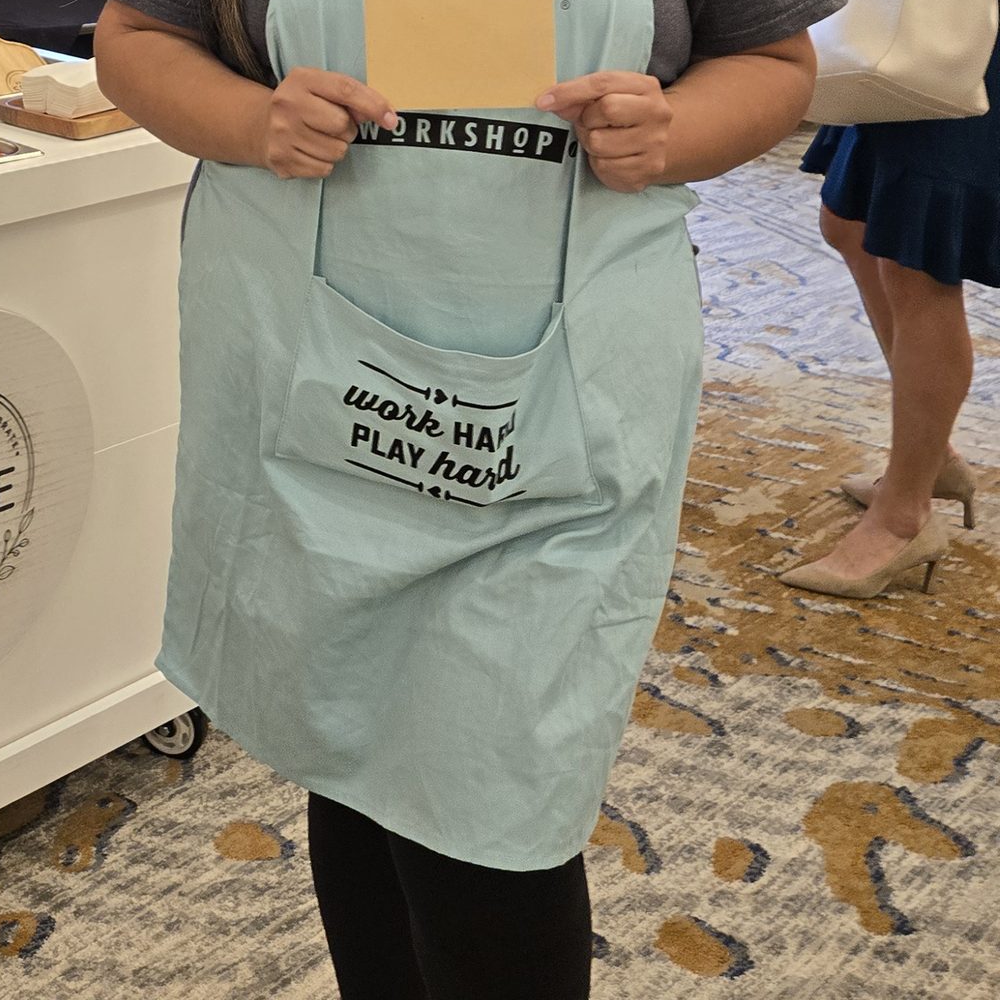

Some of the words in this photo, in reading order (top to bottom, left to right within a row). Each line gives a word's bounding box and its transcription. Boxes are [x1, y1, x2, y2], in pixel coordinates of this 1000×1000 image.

[358, 115, 554, 156] WORKSHOP
[343, 385, 445, 438] work
[350, 422, 425, 469] PLAY
[428, 445, 521, 491] hard
